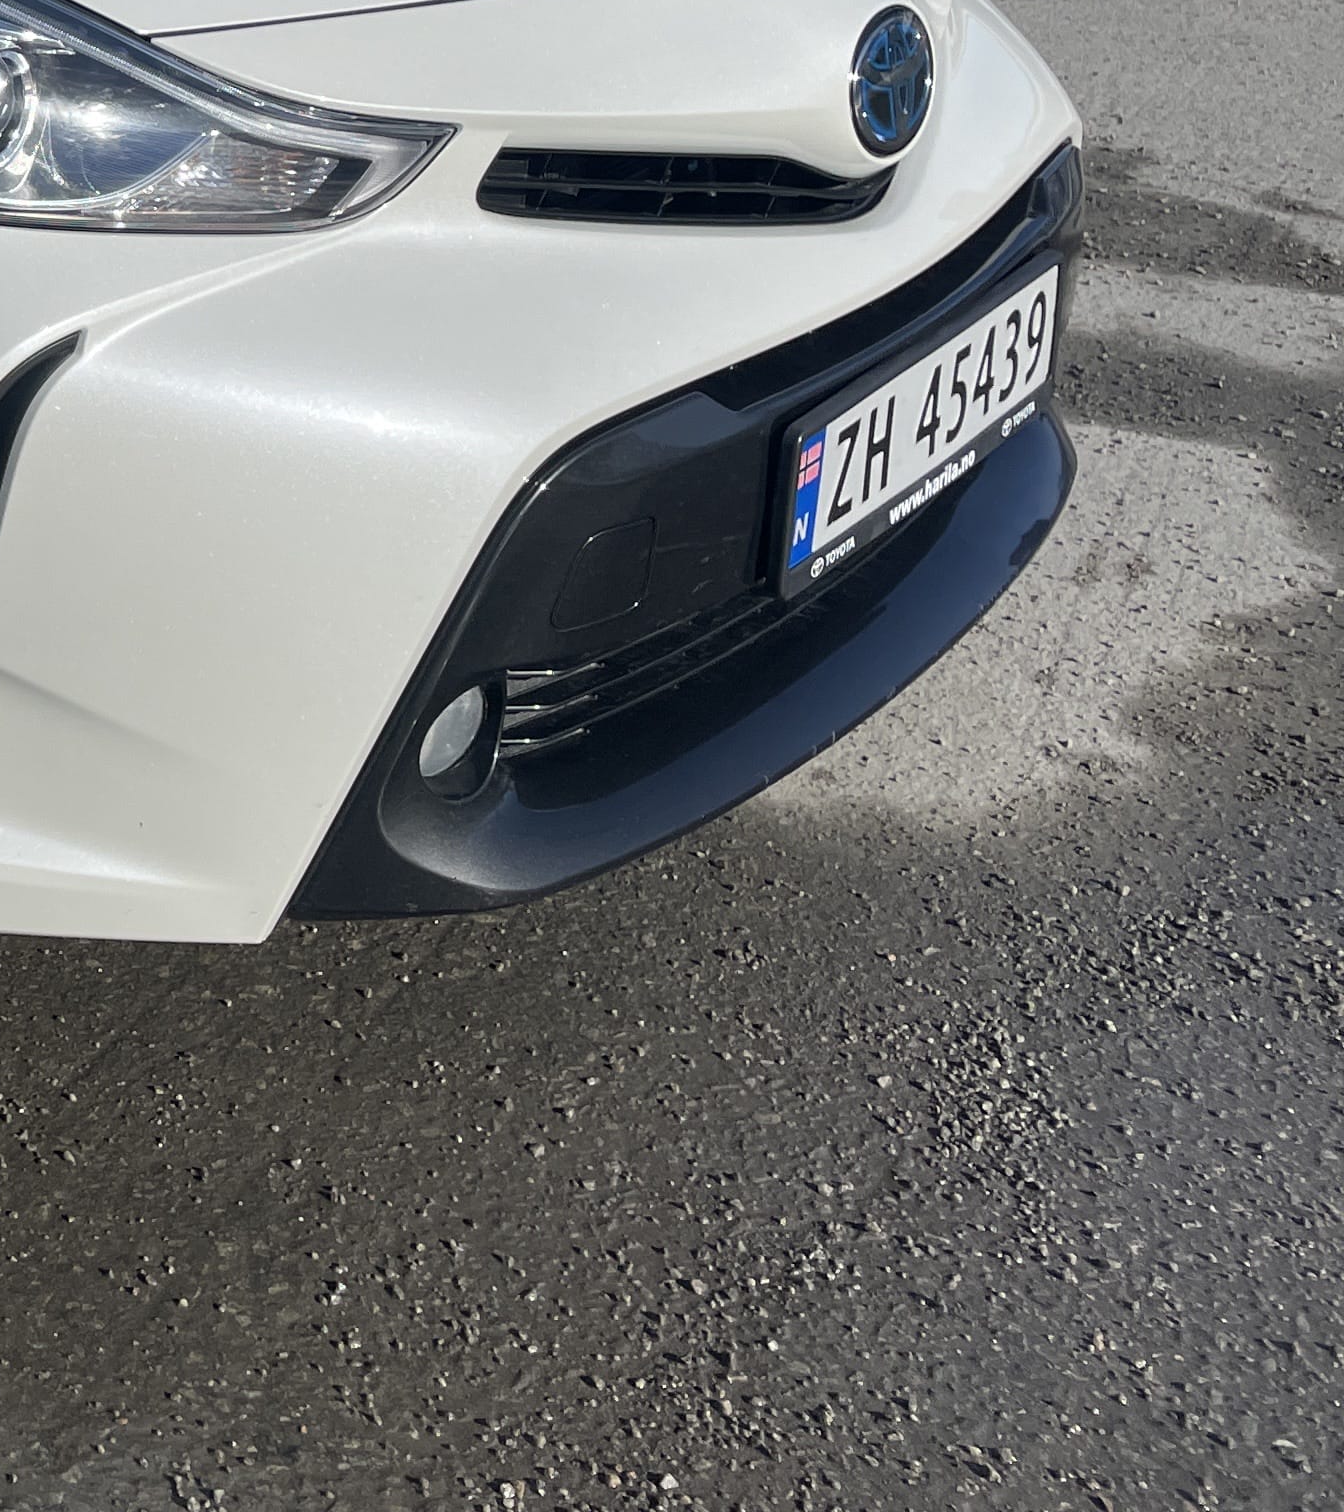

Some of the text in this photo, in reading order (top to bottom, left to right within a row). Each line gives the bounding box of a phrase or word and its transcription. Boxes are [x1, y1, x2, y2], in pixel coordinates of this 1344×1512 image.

[827, 291, 1047, 527] ZH 45439
[1012, 401, 1037, 428] TOYOTA
[889, 450, 976, 525] www.harila.no
[793, 512, 810, 546] N
[825, 536, 856, 567] TOYOTA
